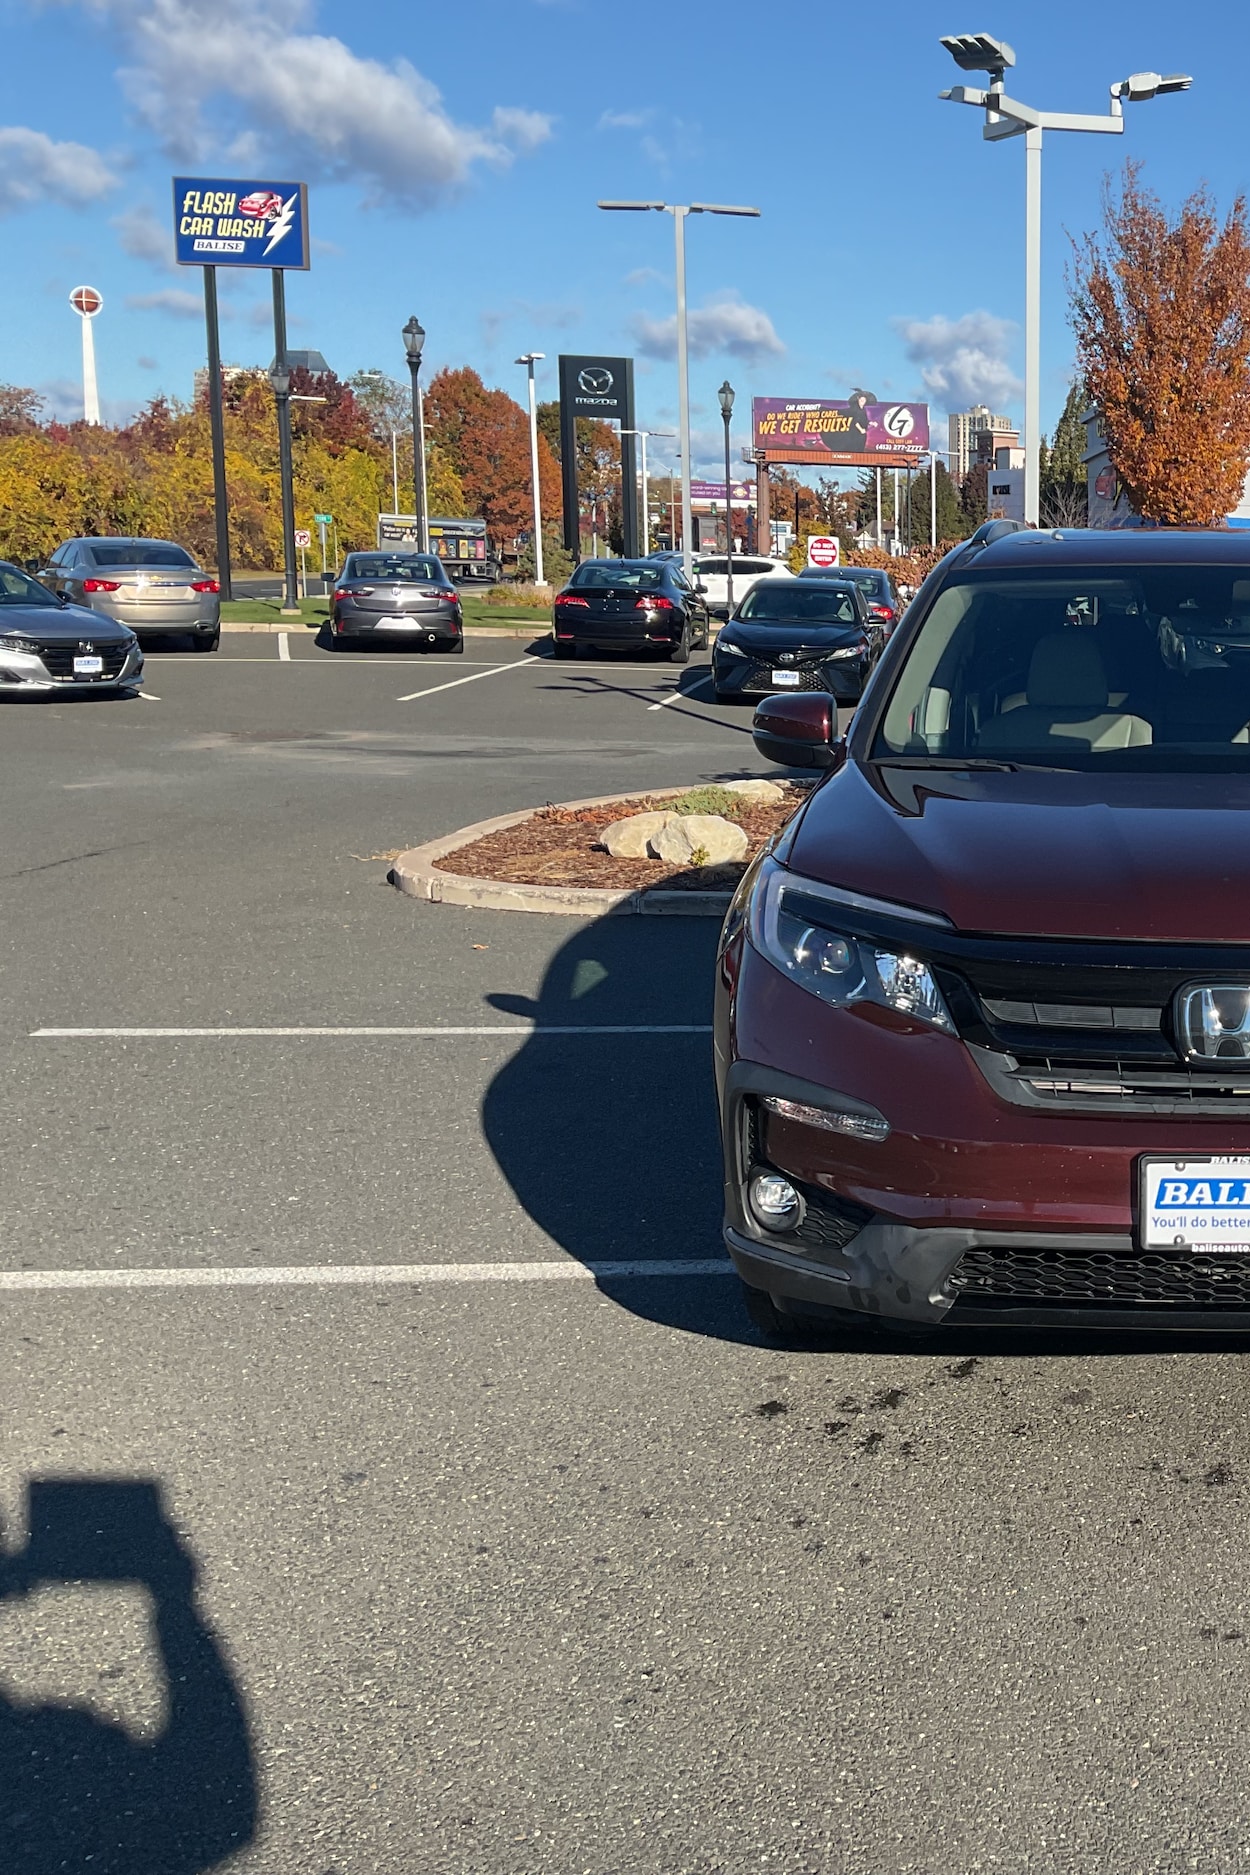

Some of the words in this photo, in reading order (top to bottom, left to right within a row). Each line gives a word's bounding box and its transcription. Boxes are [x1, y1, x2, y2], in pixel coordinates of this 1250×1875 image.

[183, 191, 236, 215] FLASH
[180, 217, 213, 236] CAR
[217, 218, 265, 238] WASH
[196, 241, 243, 251] BALISE
[575, 397, 618, 406] mazda
[777, 412, 786, 420] WE
[787, 411, 804, 420] RIDE?
[806, 411, 820, 419] WHO
[759, 420, 777, 435] WE
[780, 420, 801, 434] GET
[803, 417, 853, 433] RESULTS!
[1152, 1216, 1187, 1228] You'll
[1191, 1216, 1207, 1228] do
